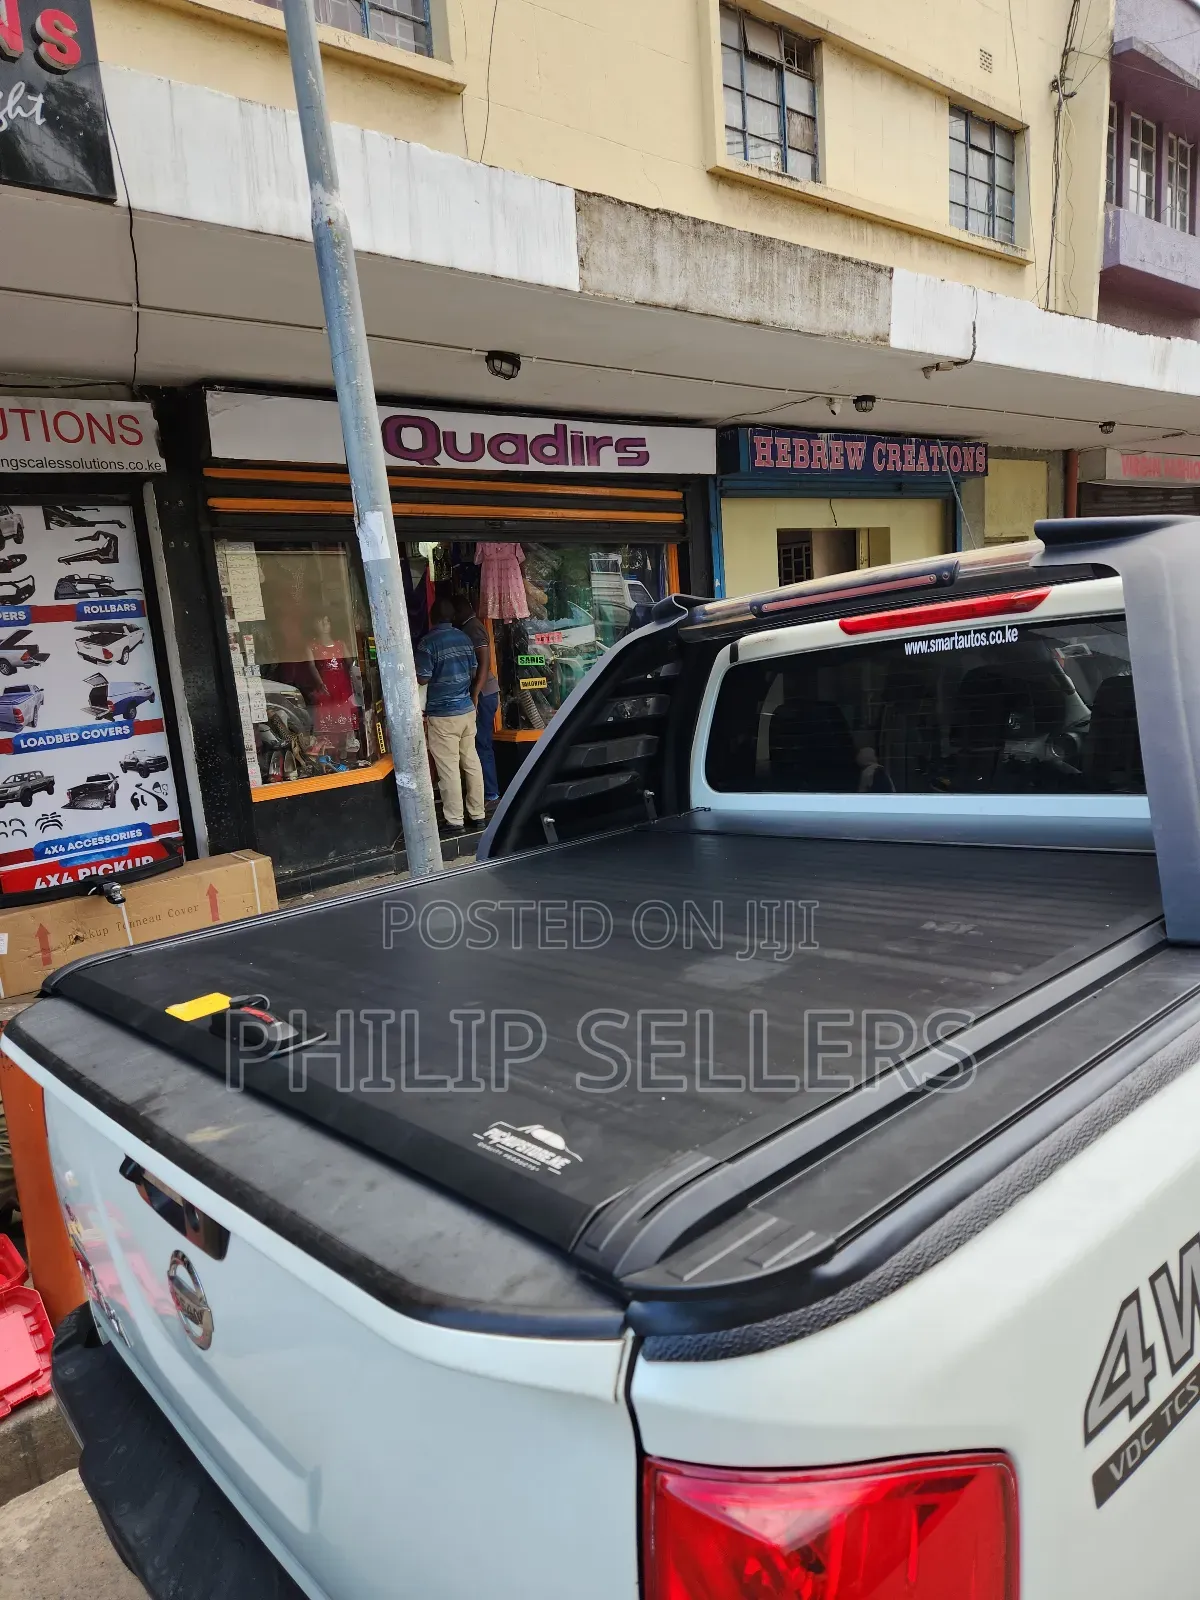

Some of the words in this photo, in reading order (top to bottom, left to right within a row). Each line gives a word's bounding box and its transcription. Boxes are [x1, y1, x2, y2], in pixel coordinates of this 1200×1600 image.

[380, 414, 650, 467] Quadirs
[754, 436, 866, 470] HEBREW
[872, 442, 987, 472] CREATIONS
[0, 611, 26, 621] ERS
[83, 603, 137, 614] ROLLBARS
[904, 626, 1019, 656] www.smartautos.co.ke
[20, 731, 79, 749] LOADBED
[82, 725, 130, 740] COVERS
[44, 845, 66, 856] 4X4
[67, 829, 143, 851] ACCESSORIES
[68, 928, 109, 945] Pckup
[167, 904, 199, 918] Cover
[1108, 1422, 1156, 1481] VDC
[1160, 1375, 1199, 1426] TCS
